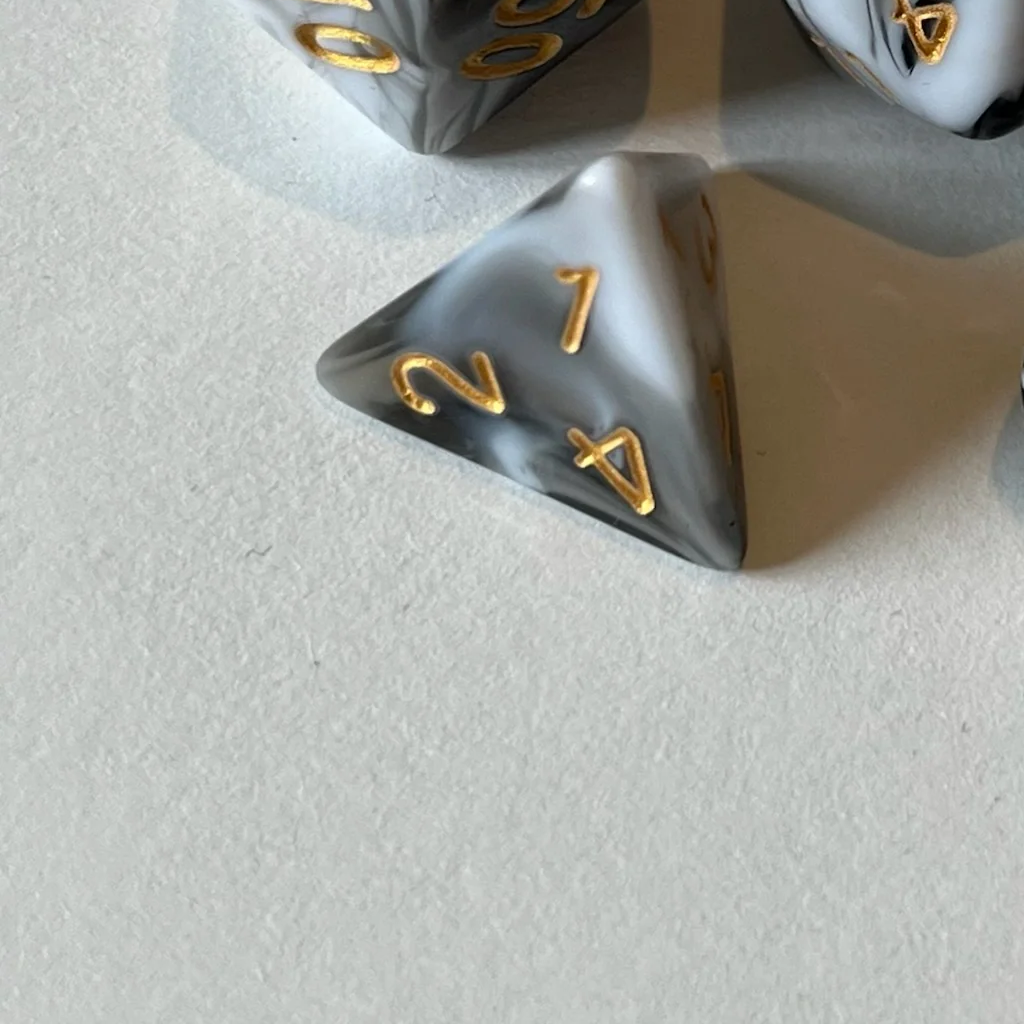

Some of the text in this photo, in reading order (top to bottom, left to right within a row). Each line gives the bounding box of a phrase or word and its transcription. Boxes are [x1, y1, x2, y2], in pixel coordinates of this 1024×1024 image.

[555, 266, 599, 354] 1
[390, 350, 506, 415] 2
[566, 426, 656, 516] 4
